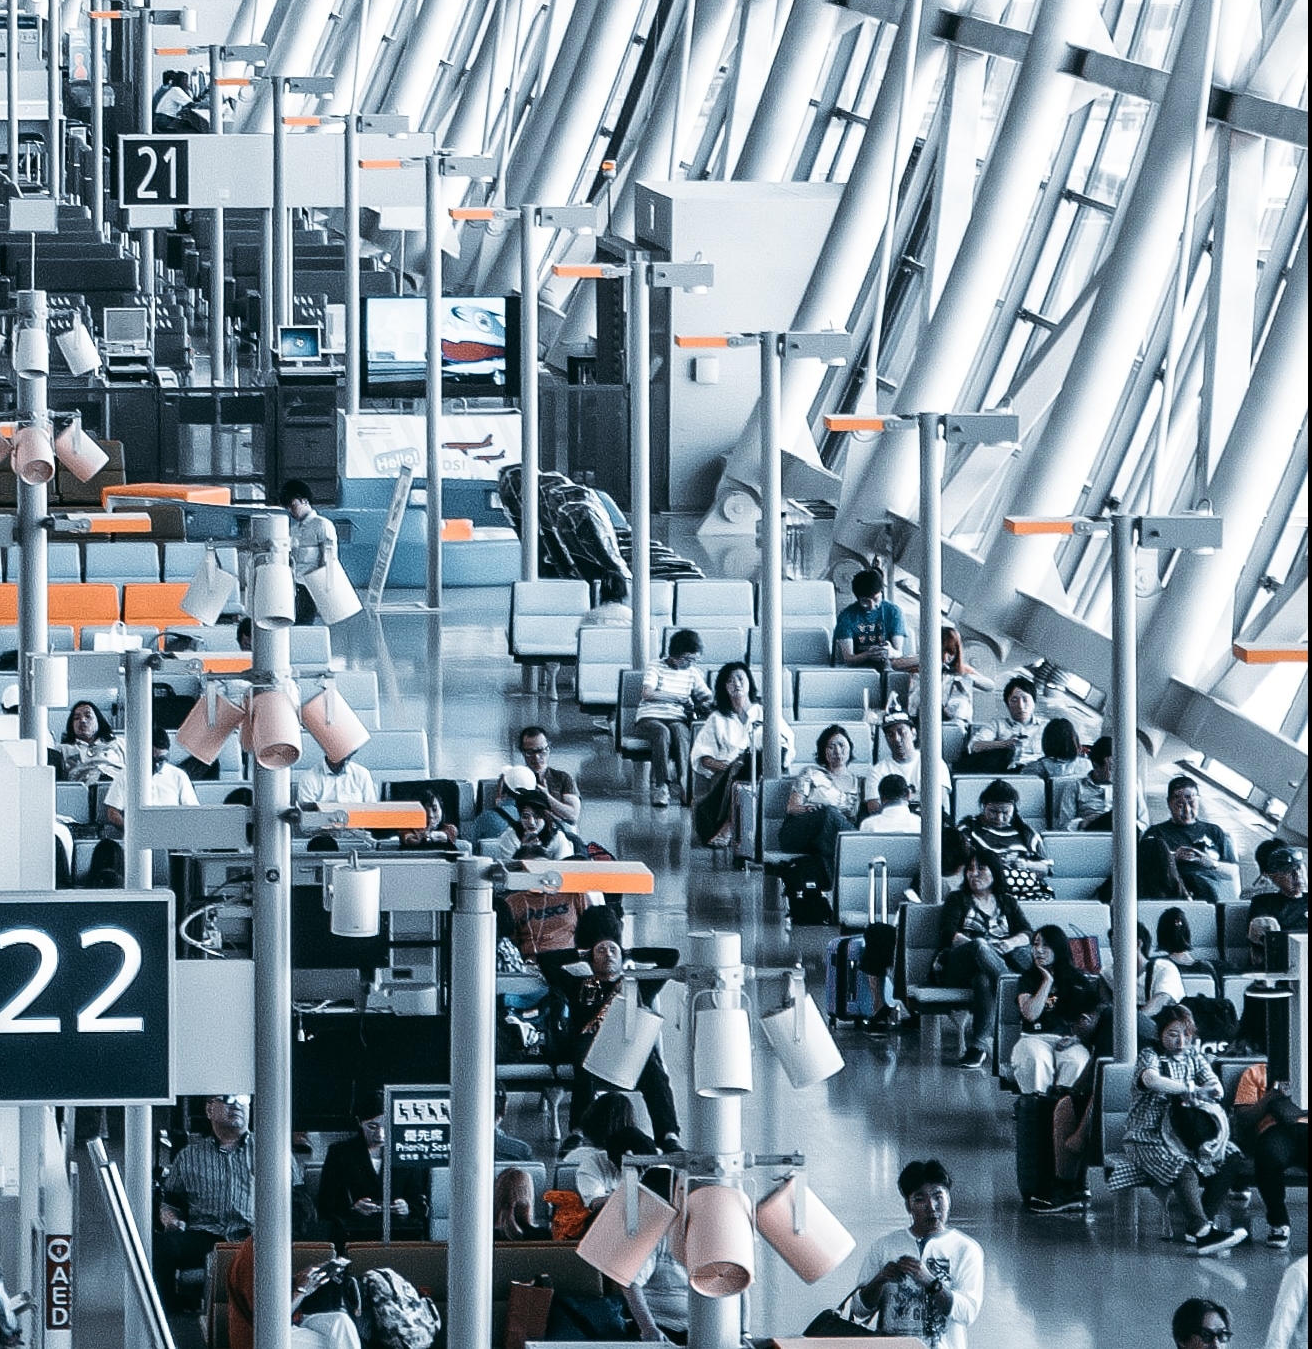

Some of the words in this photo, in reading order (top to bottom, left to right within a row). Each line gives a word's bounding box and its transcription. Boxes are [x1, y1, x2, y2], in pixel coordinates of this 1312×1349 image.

[137, 146, 177, 199] 21
[395, 1142, 430, 1153] Priority
[50, 1266, 70, 1326] AED
